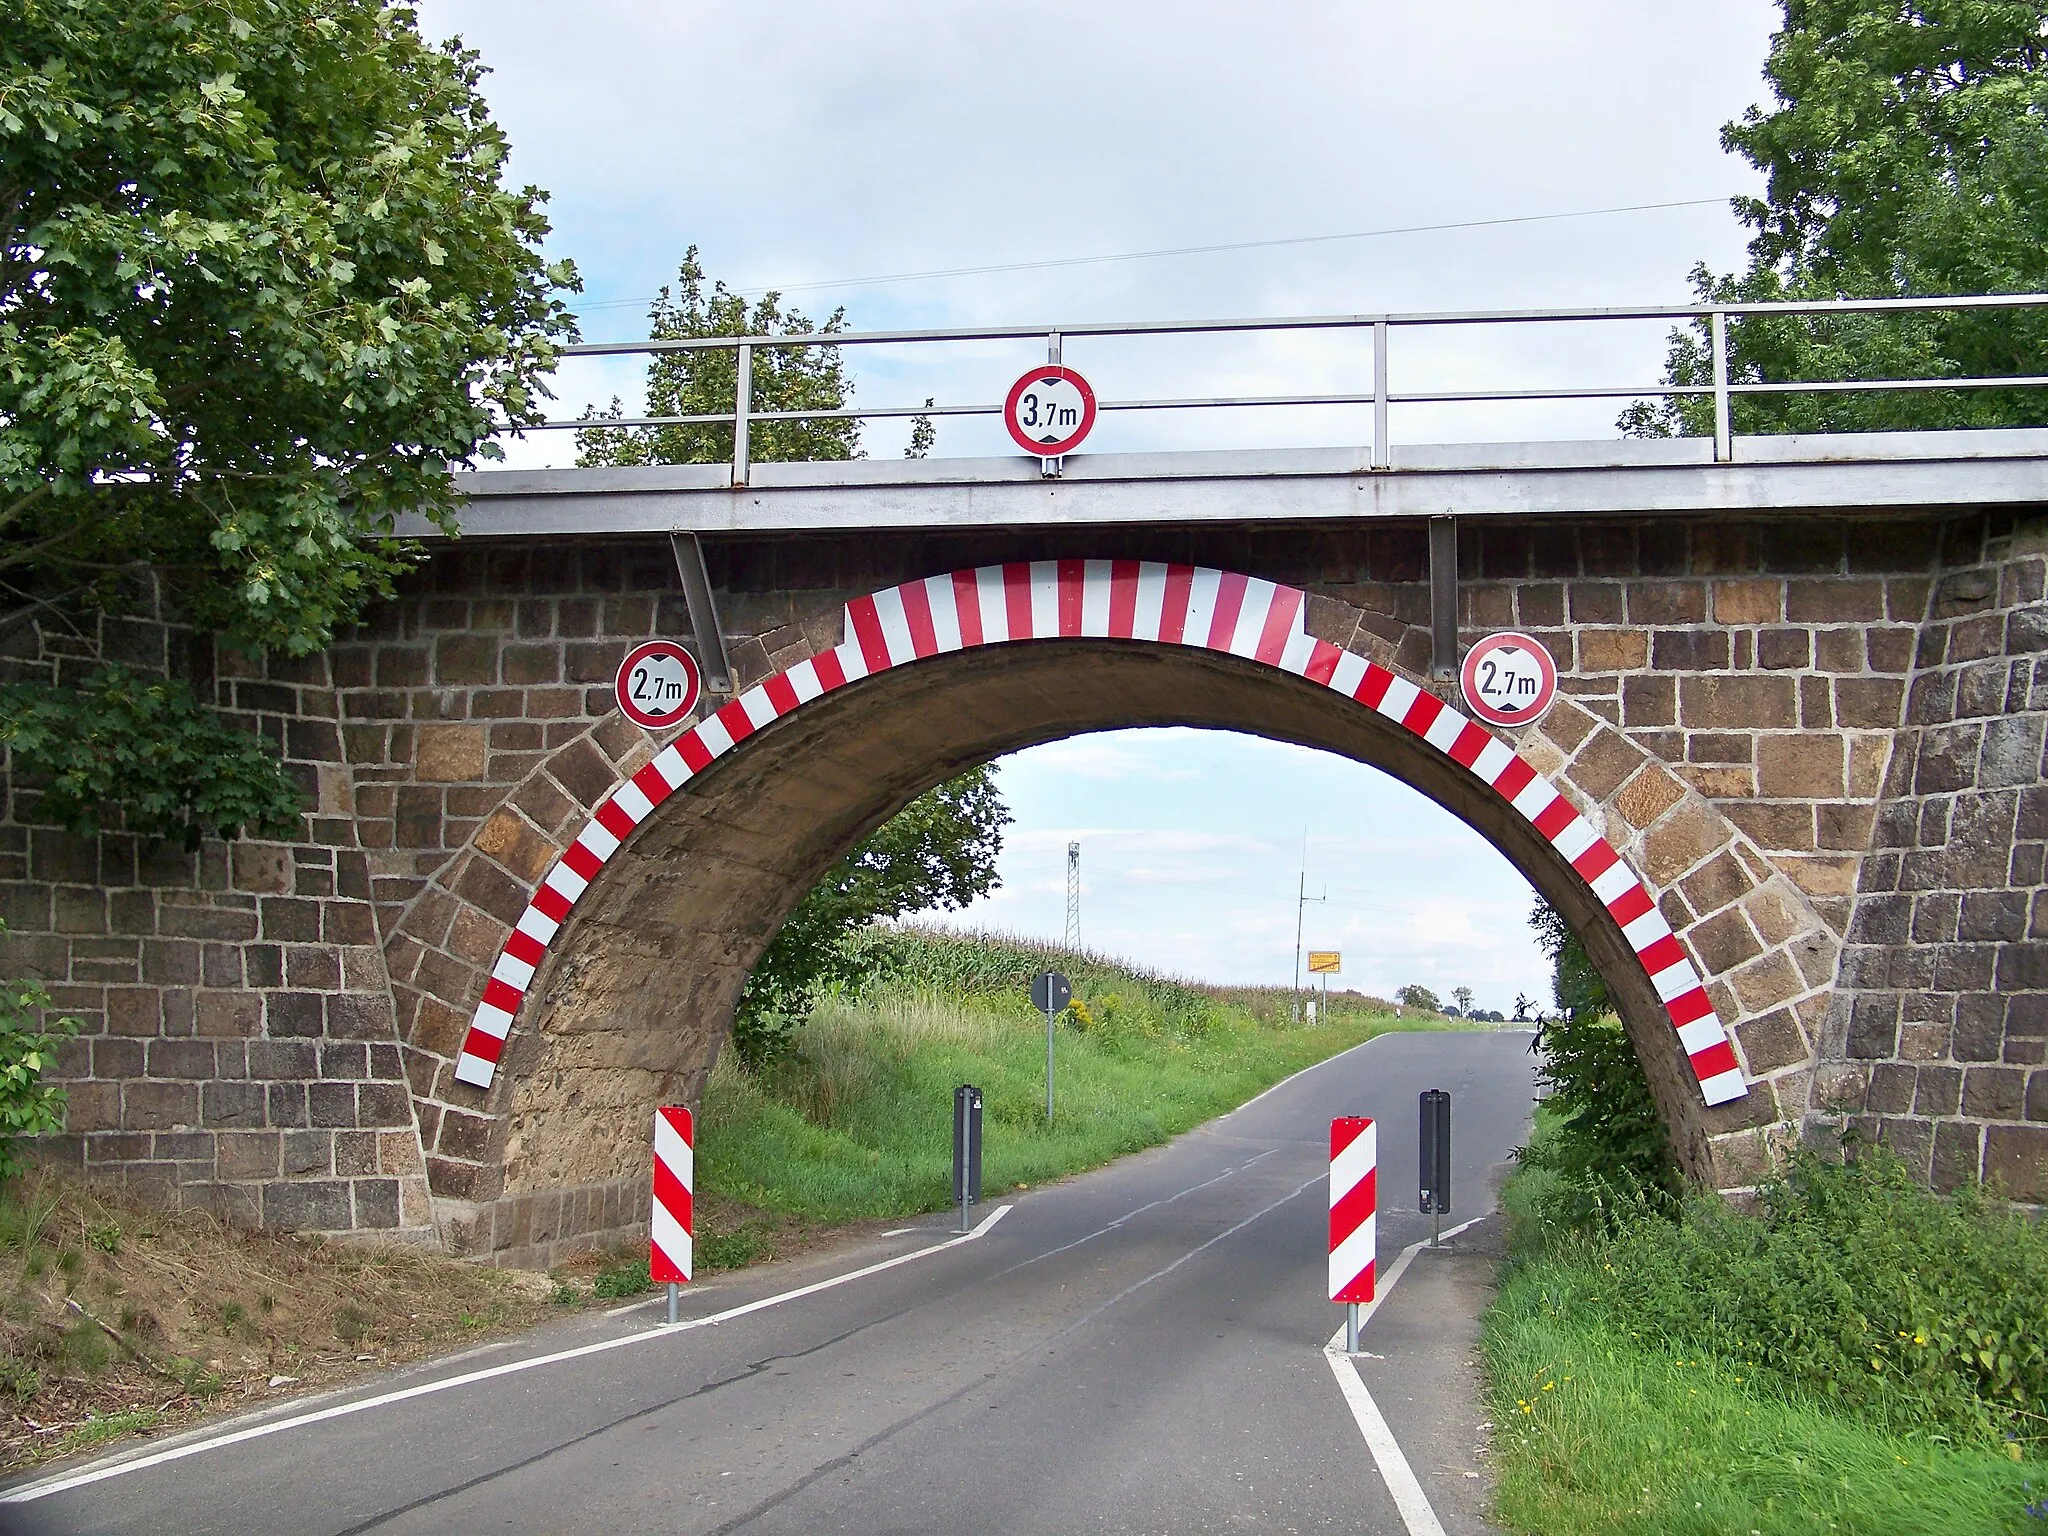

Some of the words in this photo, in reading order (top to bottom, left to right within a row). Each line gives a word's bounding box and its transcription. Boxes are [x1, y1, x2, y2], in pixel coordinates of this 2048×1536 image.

[1023, 393, 1077, 428] 3,7m
[633, 667, 682, 701] 2,7m
[1481, 660, 1536, 696] 2,7m
